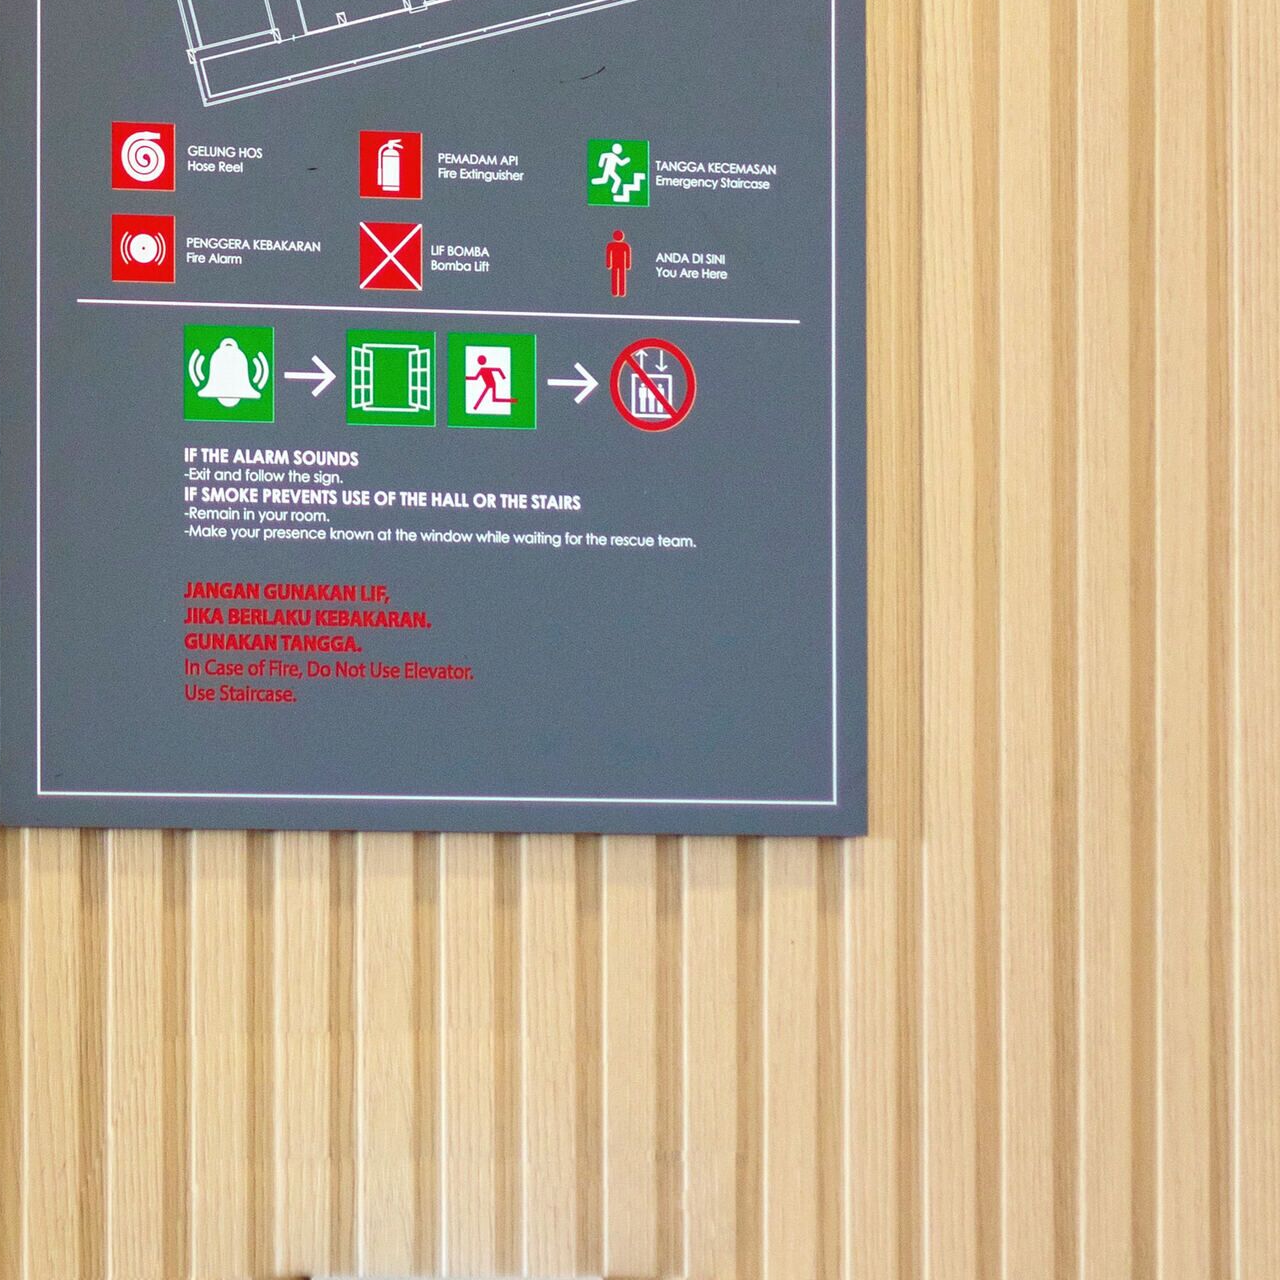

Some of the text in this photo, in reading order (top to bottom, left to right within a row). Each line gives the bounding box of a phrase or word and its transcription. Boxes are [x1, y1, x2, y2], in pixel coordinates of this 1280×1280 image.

[188, 146, 262, 158] GELUNG HOS
[438, 153, 518, 165] PEMADAM API
[188, 161, 243, 172] Hose Reel
[656, 161, 776, 174] TANGGA KECEMASAN
[438, 168, 524, 182] Fire Extinguisher
[656, 175, 770, 189] Emergency Staircase
[187, 238, 320, 251] PENGGERA KEBAKARAN
[431, 245, 489, 257] LIF BOMBA
[187, 252, 242, 264] Fire Alarm
[656, 253, 725, 264] ANDA DI SINI
[431, 260, 489, 272] Bomba Lift
[656, 267, 727, 279] You Are Here
[185, 448, 359, 466] IF THE ALARM SOUNDS
[214, 469, 241, 481] and
[245, 469, 285, 482] follow
[288, 470, 310, 483] the
[314, 471, 343, 486] sign.
[185, 487, 581, 510] IF SMOKE PREVENTS USE OF THE HALL OR THE STAIRS
[244, 508, 255, 520] in
[258, 511, 288, 523] your
[291, 512, 329, 522] room.
[231, 528, 260, 540] your
[264, 529, 326, 540] presence
[330, 527, 374, 540] known
[378, 529, 391, 541] at
[396, 529, 417, 541] the
[420, 529, 473, 542] window
[476, 531, 510, 543] while
[513, 532, 561, 547] waiting
[565, 532, 583, 545] for
[586, 533, 607, 546] the
[611, 536, 654, 546] rescue
[658, 535, 696, 547] team.
[185, 582, 389, 603] JANGAN GUNAKAN LIF,
[185, 608, 431, 628] JIKA BERLAKU KEBAKARAN.
[185, 633, 362, 652] GUNAKAN TANGGA.
[185, 658, 473, 680] In Case of Fire, Do Not Use Elevator.
[185, 684, 296, 703] Use Staircase.
